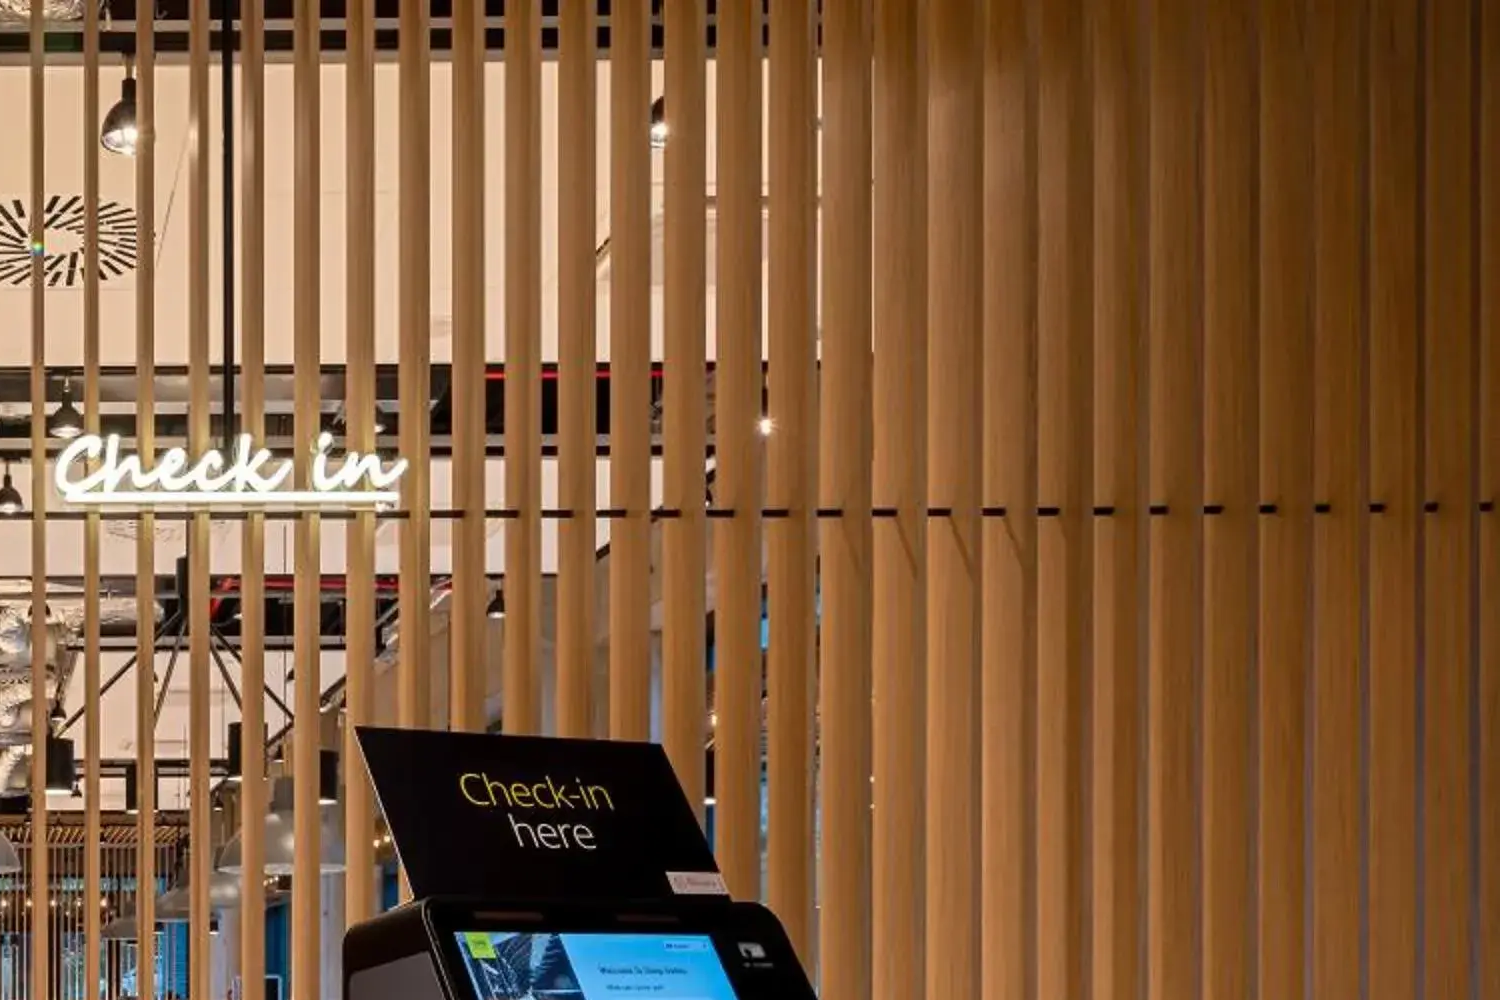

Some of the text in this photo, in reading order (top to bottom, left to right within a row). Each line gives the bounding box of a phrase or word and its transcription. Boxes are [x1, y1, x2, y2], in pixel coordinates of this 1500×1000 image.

[55, 431, 409, 495] Check in
[459, 771, 615, 812] Check-in
[507, 812, 597, 850] here
